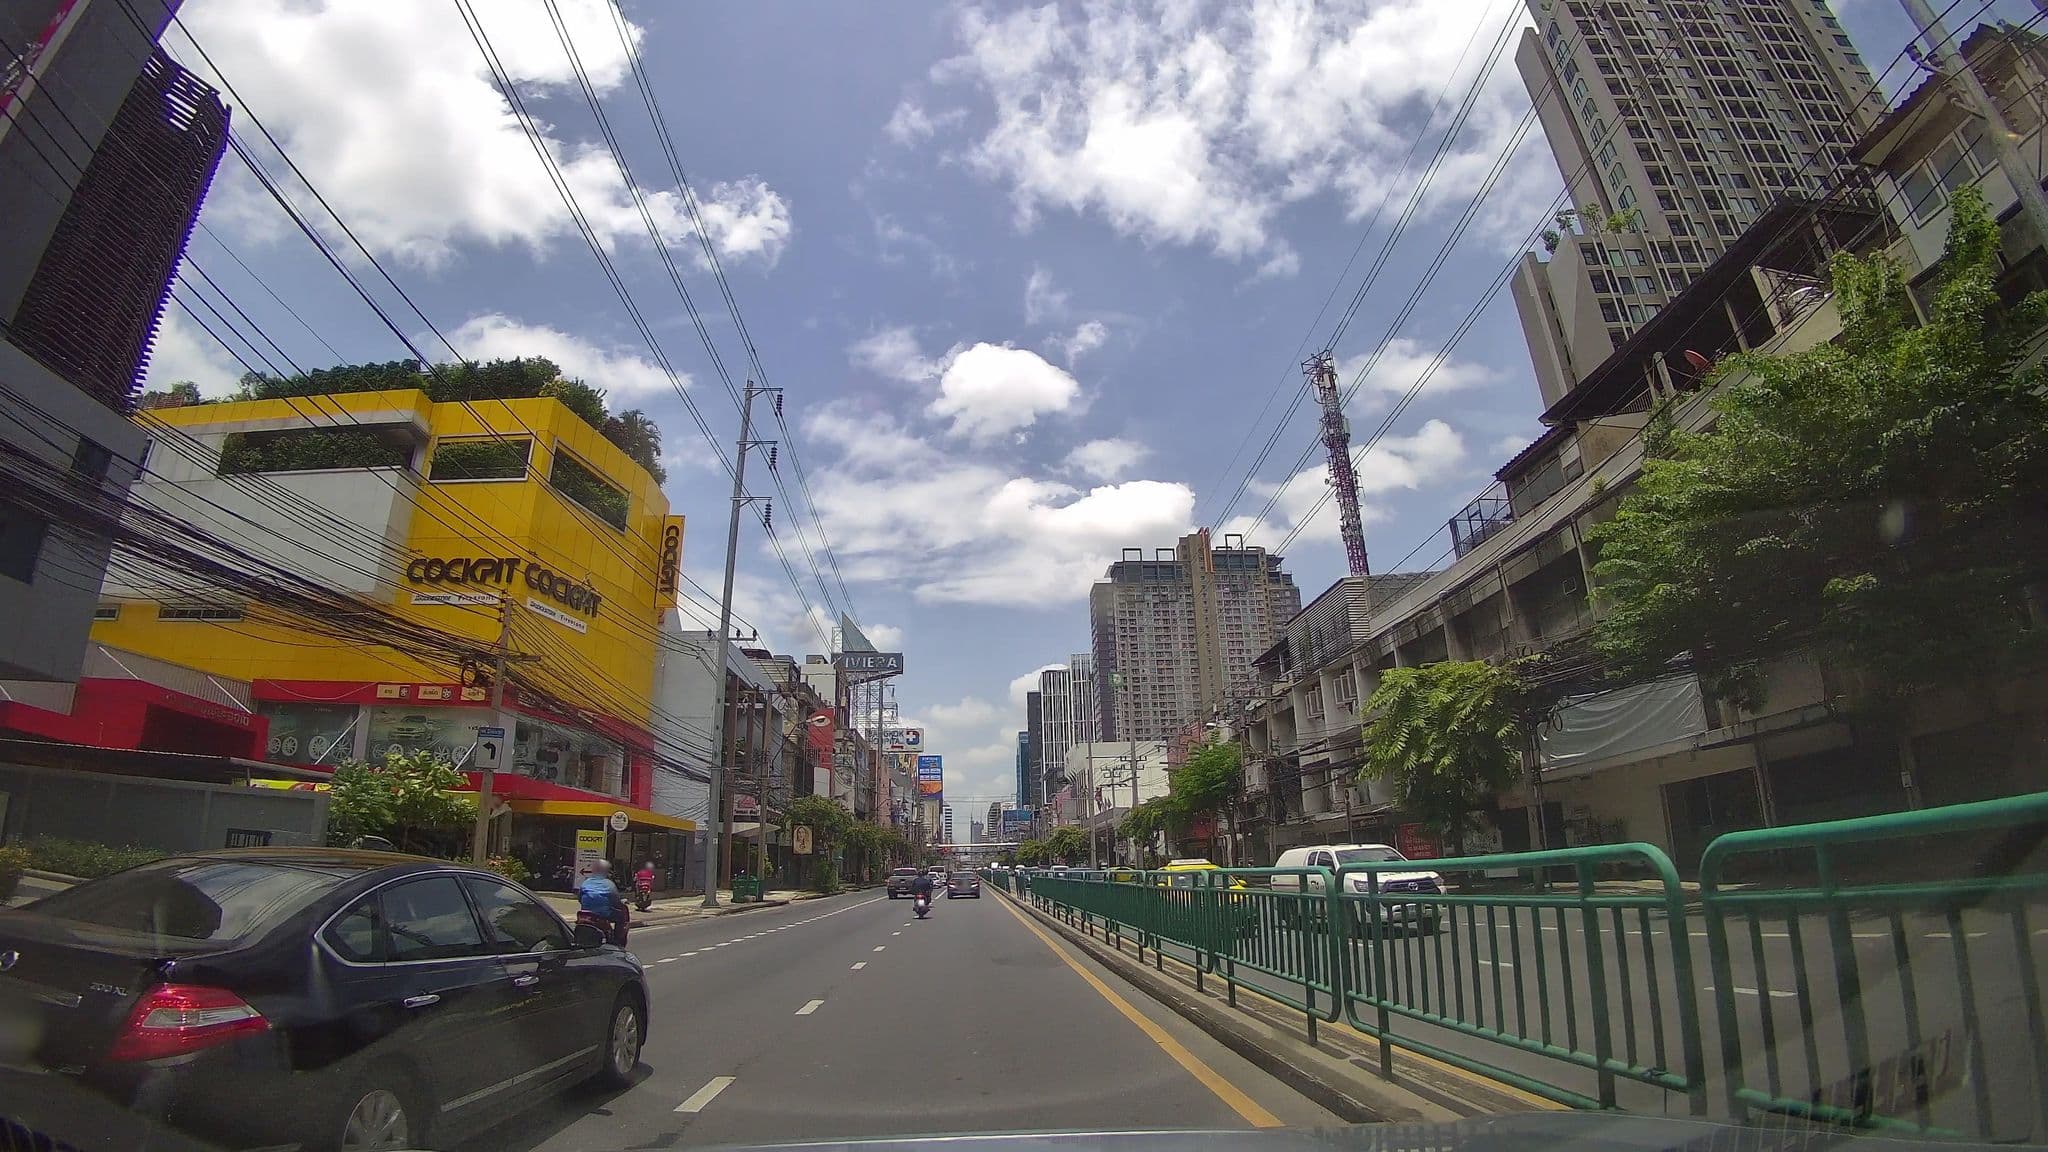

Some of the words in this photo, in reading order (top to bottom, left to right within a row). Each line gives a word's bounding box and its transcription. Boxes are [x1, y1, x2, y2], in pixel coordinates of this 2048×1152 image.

[407, 557, 520, 584] COCKPIT
[659, 525, 680, 595] COCKPIT
[524, 562, 602, 618] COCKPIT
